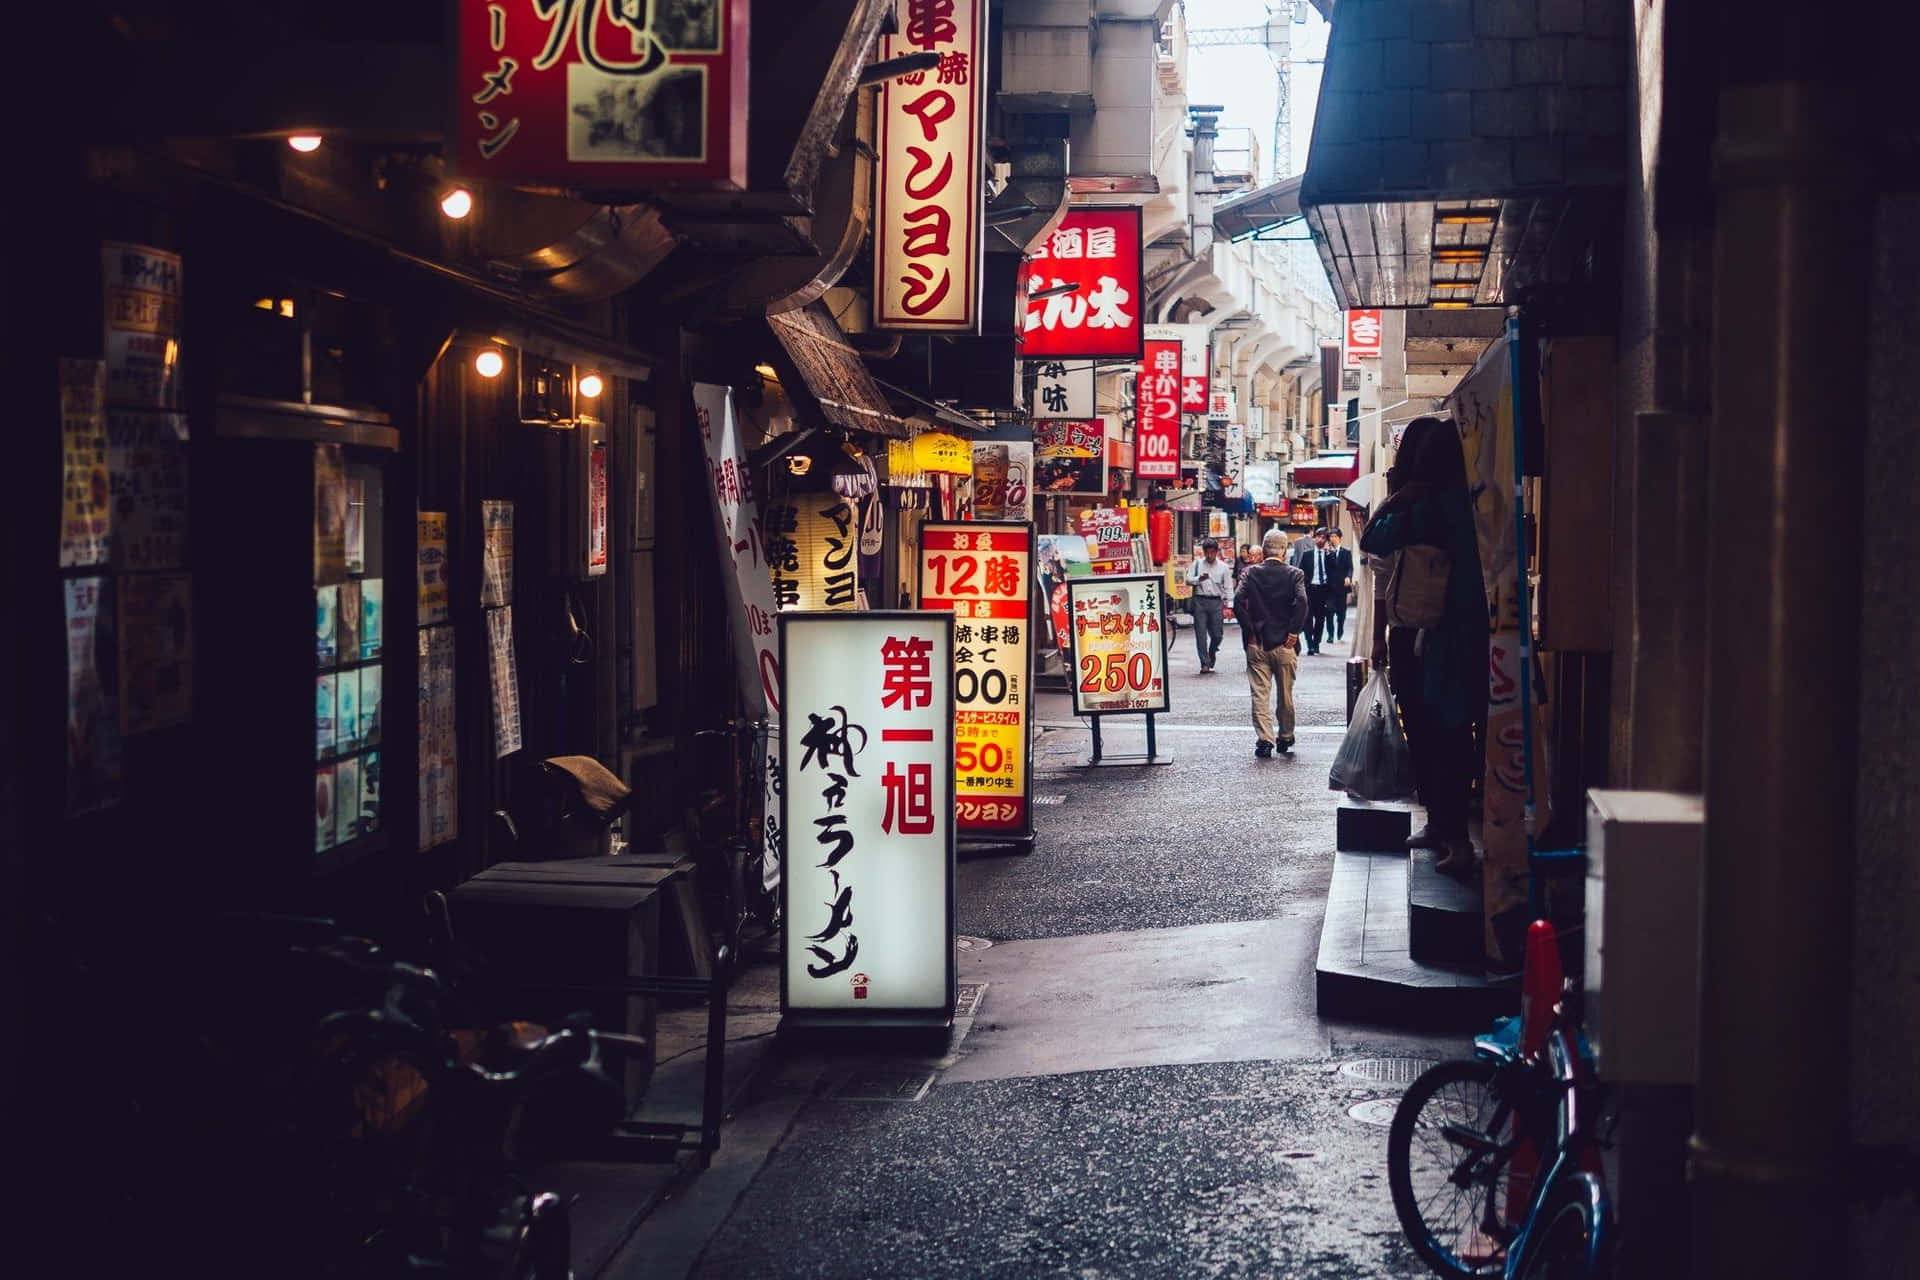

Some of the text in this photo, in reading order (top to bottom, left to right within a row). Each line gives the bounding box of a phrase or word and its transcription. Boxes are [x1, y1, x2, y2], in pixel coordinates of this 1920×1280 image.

[901, 89, 956, 316] マンヨシ
[1155, 350, 1178, 420] 串かつ
[927, 554, 1020, 597] 12時
[1076, 611, 1160, 637] サービスタイム
[1079, 652, 1153, 693] 250
[880, 636, 935, 836] 第一旭
